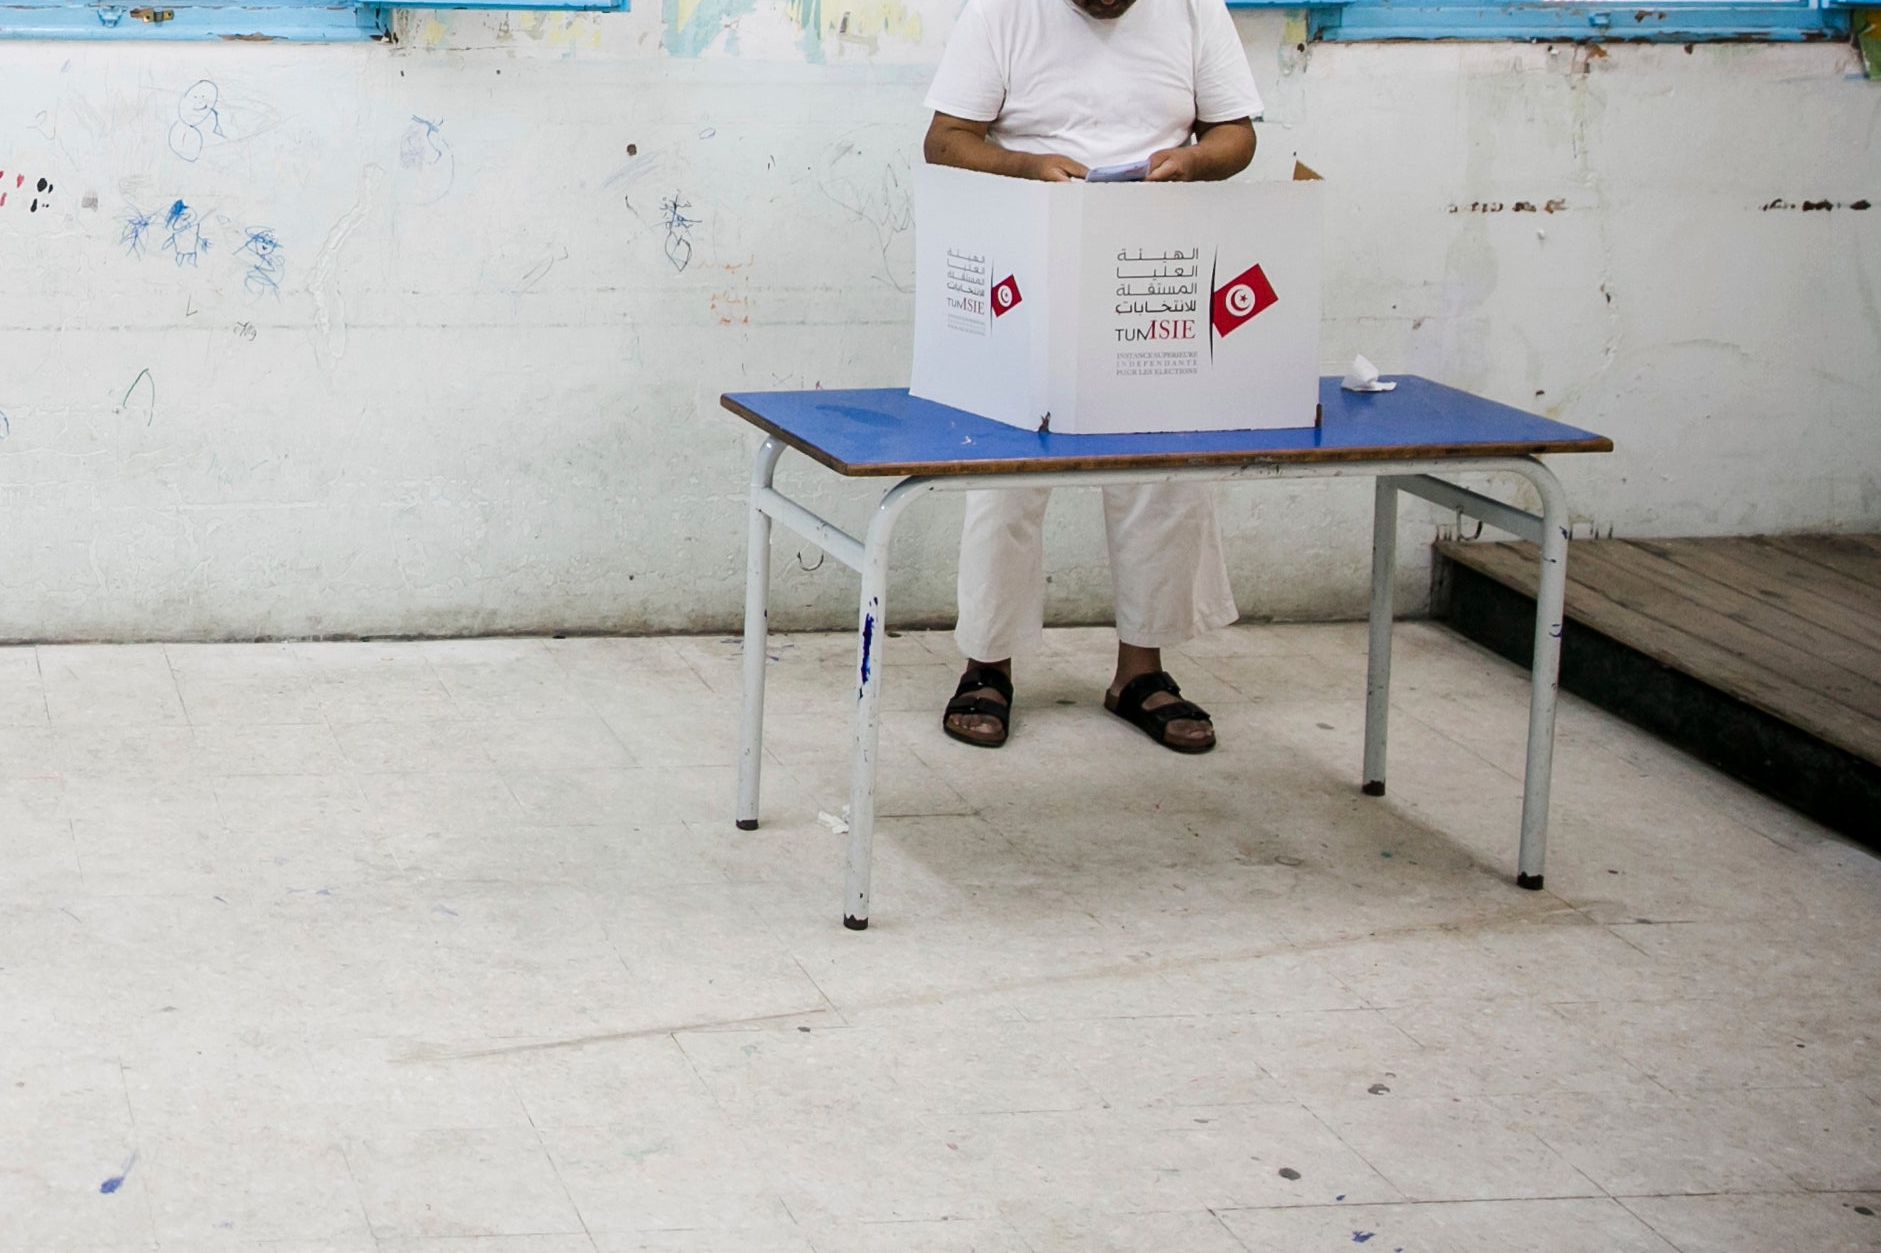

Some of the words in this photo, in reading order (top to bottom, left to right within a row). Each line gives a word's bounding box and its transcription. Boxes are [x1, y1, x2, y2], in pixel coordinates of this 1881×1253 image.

[1117, 247, 1199, 263] الهيئة
[1117, 265, 1198, 281] العليا
[1116, 283, 1197, 296] المستقلة
[1115, 300, 1196, 316] للانتخابات
